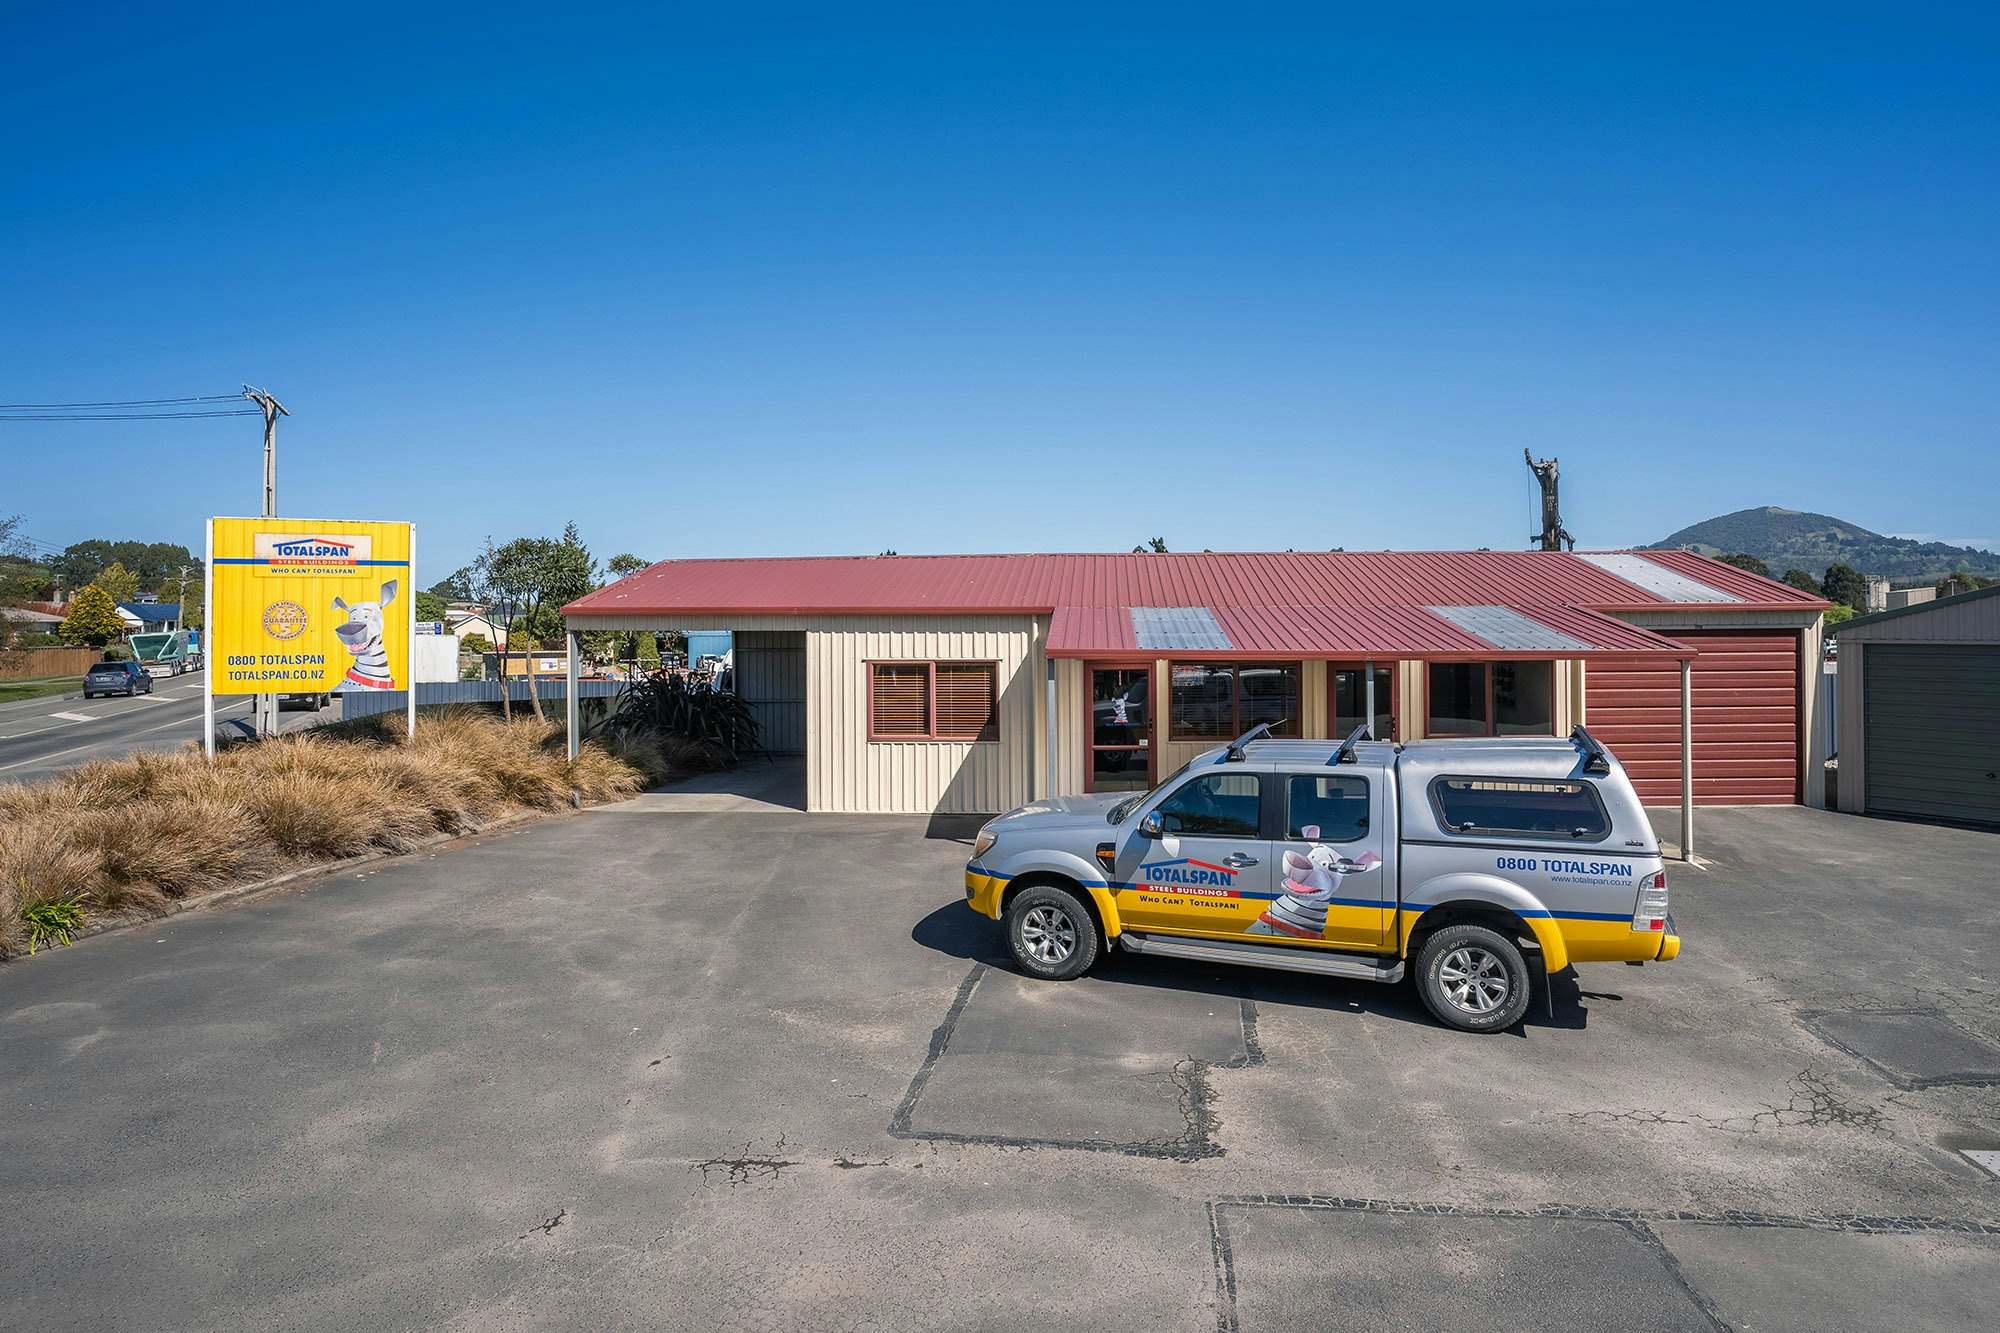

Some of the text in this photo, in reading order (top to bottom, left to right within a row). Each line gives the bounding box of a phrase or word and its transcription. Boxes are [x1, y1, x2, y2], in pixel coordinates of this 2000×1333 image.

[276, 544, 349, 556] TOTALSPAN
[270, 606, 297, 618] 25
[280, 624, 292, 636] 5
[228, 655, 324, 665] 0800 TOTALSPAN
[228, 670, 324, 680] TOTALSPAN.CO.NZ
[1497, 857, 1632, 876] 0800 TOTALSPAN
[1144, 866, 1232, 886] TOTALSPAN
[1551, 875, 1632, 886] www.totalspan.co.nz
[1177, 887, 1228, 897] BUILDINGS
